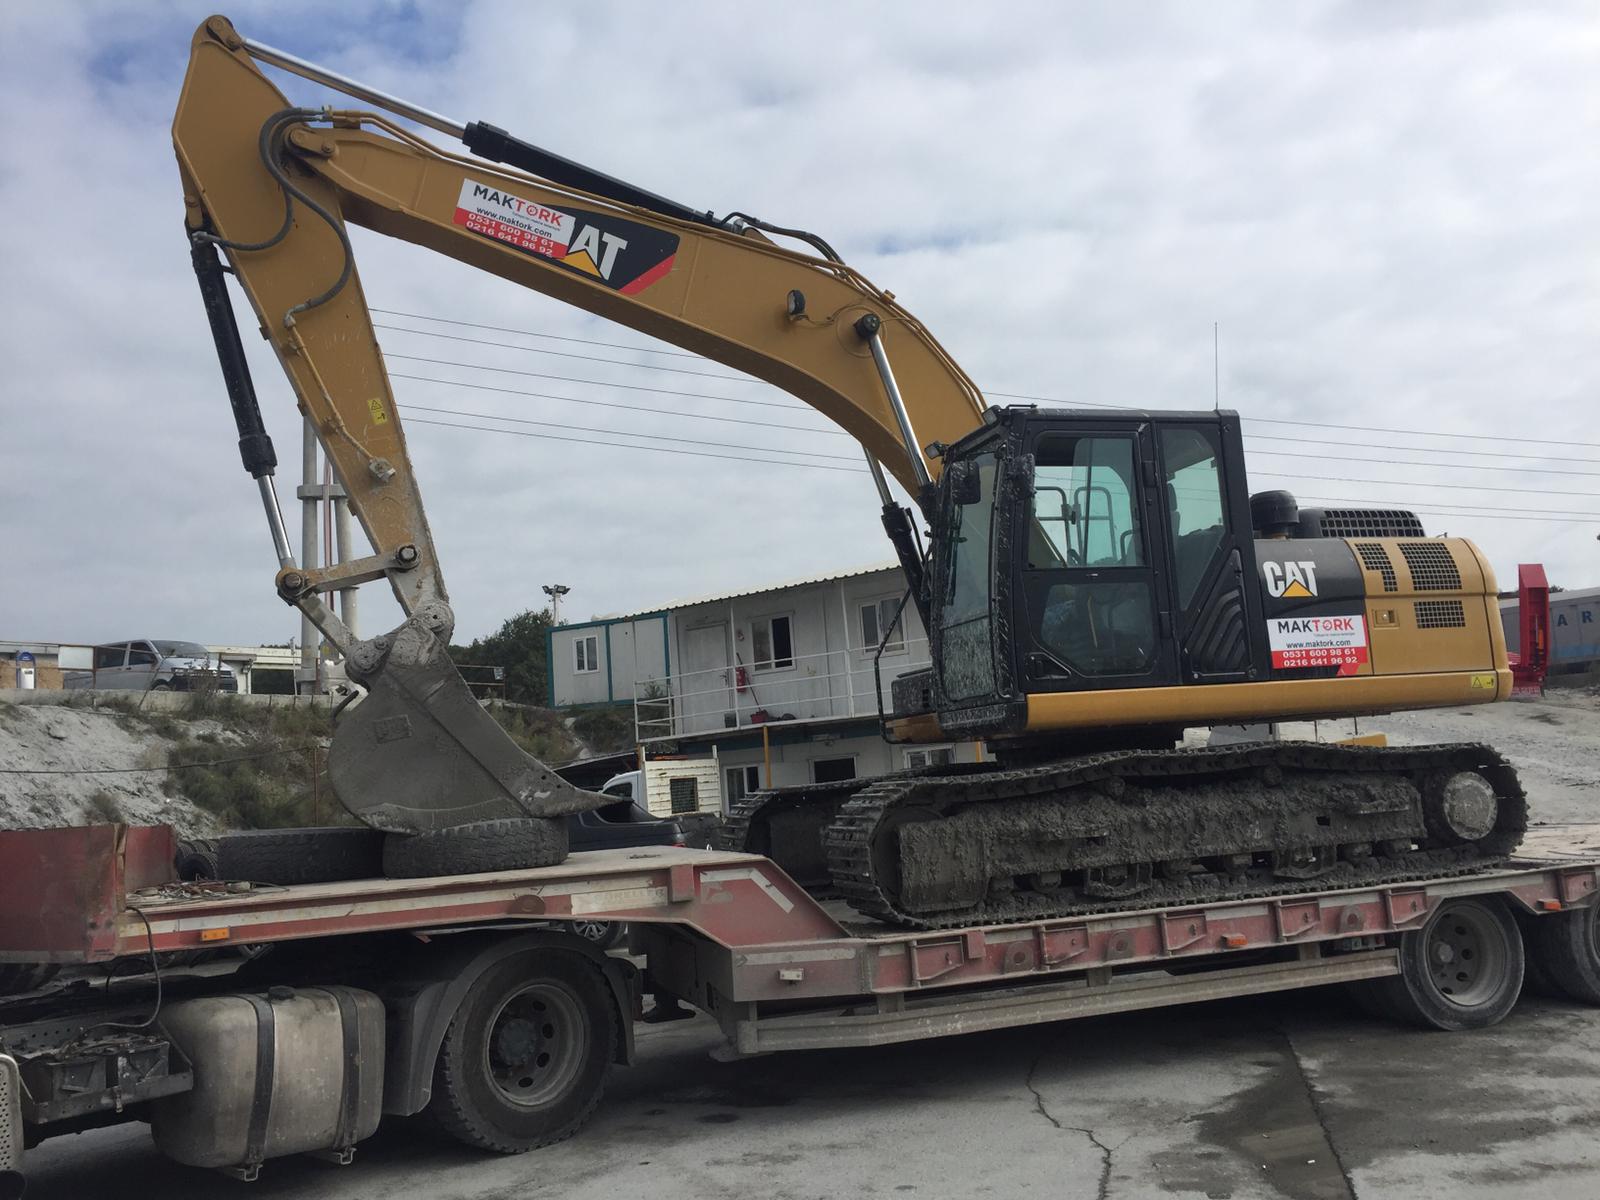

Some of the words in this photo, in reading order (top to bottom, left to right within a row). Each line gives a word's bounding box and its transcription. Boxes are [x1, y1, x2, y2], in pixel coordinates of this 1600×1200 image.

[473, 184, 563, 226] MAKTORK
[466, 220, 495, 236] 0216
[497, 231, 518, 244] 641
[522, 240, 536, 250] 96
[539, 246, 553, 258] 92
[468, 213, 496, 228] 0531
[500, 224, 521, 236] 600
[541, 238, 554, 248] 61
[476, 206, 552, 239] www.maktork.com
[567, 223, 628, 281] AT
[1262, 560, 1318, 598] CAT
[1277, 618, 1354, 634] MAKTORK
[1282, 650, 1306, 658] 0531
[1309, 649, 1328, 657] 600
[1286, 639, 1351, 649] www.maktork.com
[1283, 658, 1308, 667] 0216
[1310, 658, 1328, 666] 641
[1331, 657, 1343, 665] 96
[1345, 656, 1358, 664] 92
